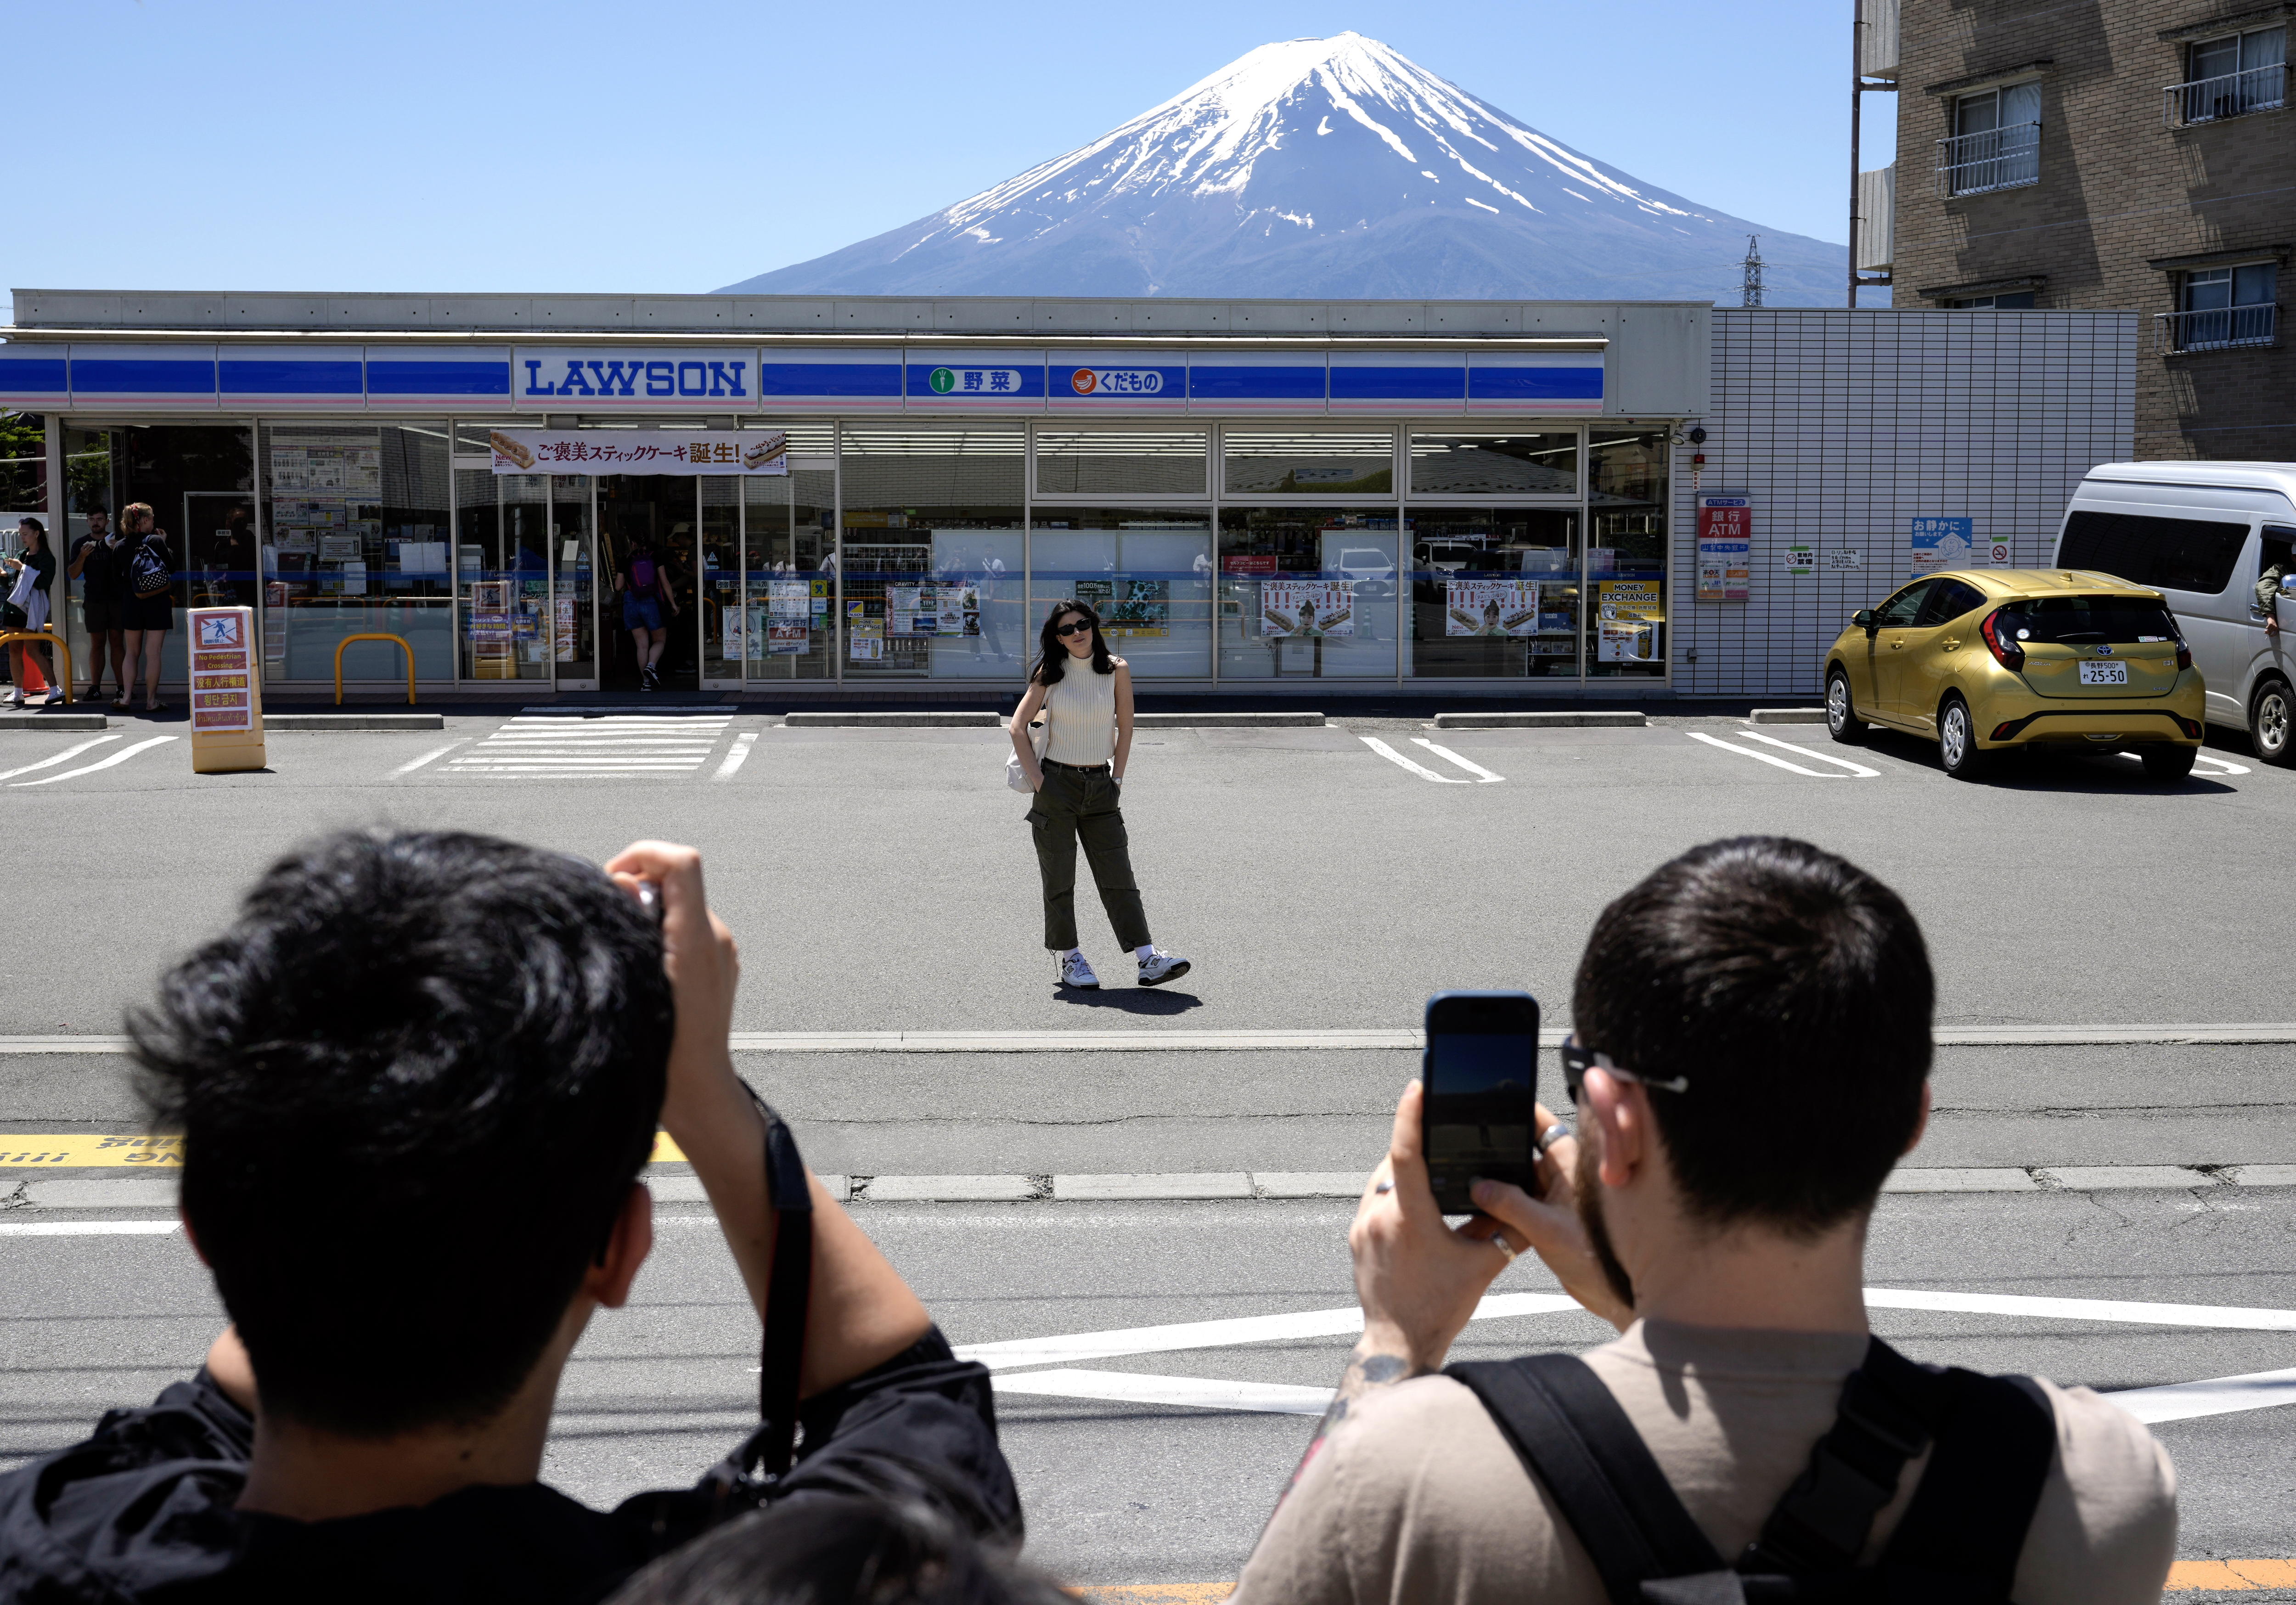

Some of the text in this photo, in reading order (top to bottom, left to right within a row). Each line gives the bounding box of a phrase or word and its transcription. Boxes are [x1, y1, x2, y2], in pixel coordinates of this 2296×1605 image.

[525, 360, 746, 396] LAWSON
[964, 372, 1010, 390] 野菜
[1100, 372, 1157, 391] くだもの
[538, 441, 740, 463] ご褒美スティックケーキ誕生!
[1712, 511, 1740, 522] 銀行
[1708, 524, 1740, 535] ATM
[1914, 520, 1960, 531] お静かに
[1263, 581, 1353, 591] ご褒美スティックケーキ誕生!
[1448, 581, 1537, 591] ご褒美スティックケーキ誕生!
[775, 629, 801, 638] ATM
[2090, 670, 2124, 682] 25-50
[197, 676, 246, 688] 没有人行横道
[204, 693, 238, 706] 횡단 금지
[196, 713, 247, 724] ห้ามคนเดินเท้าข้าม
